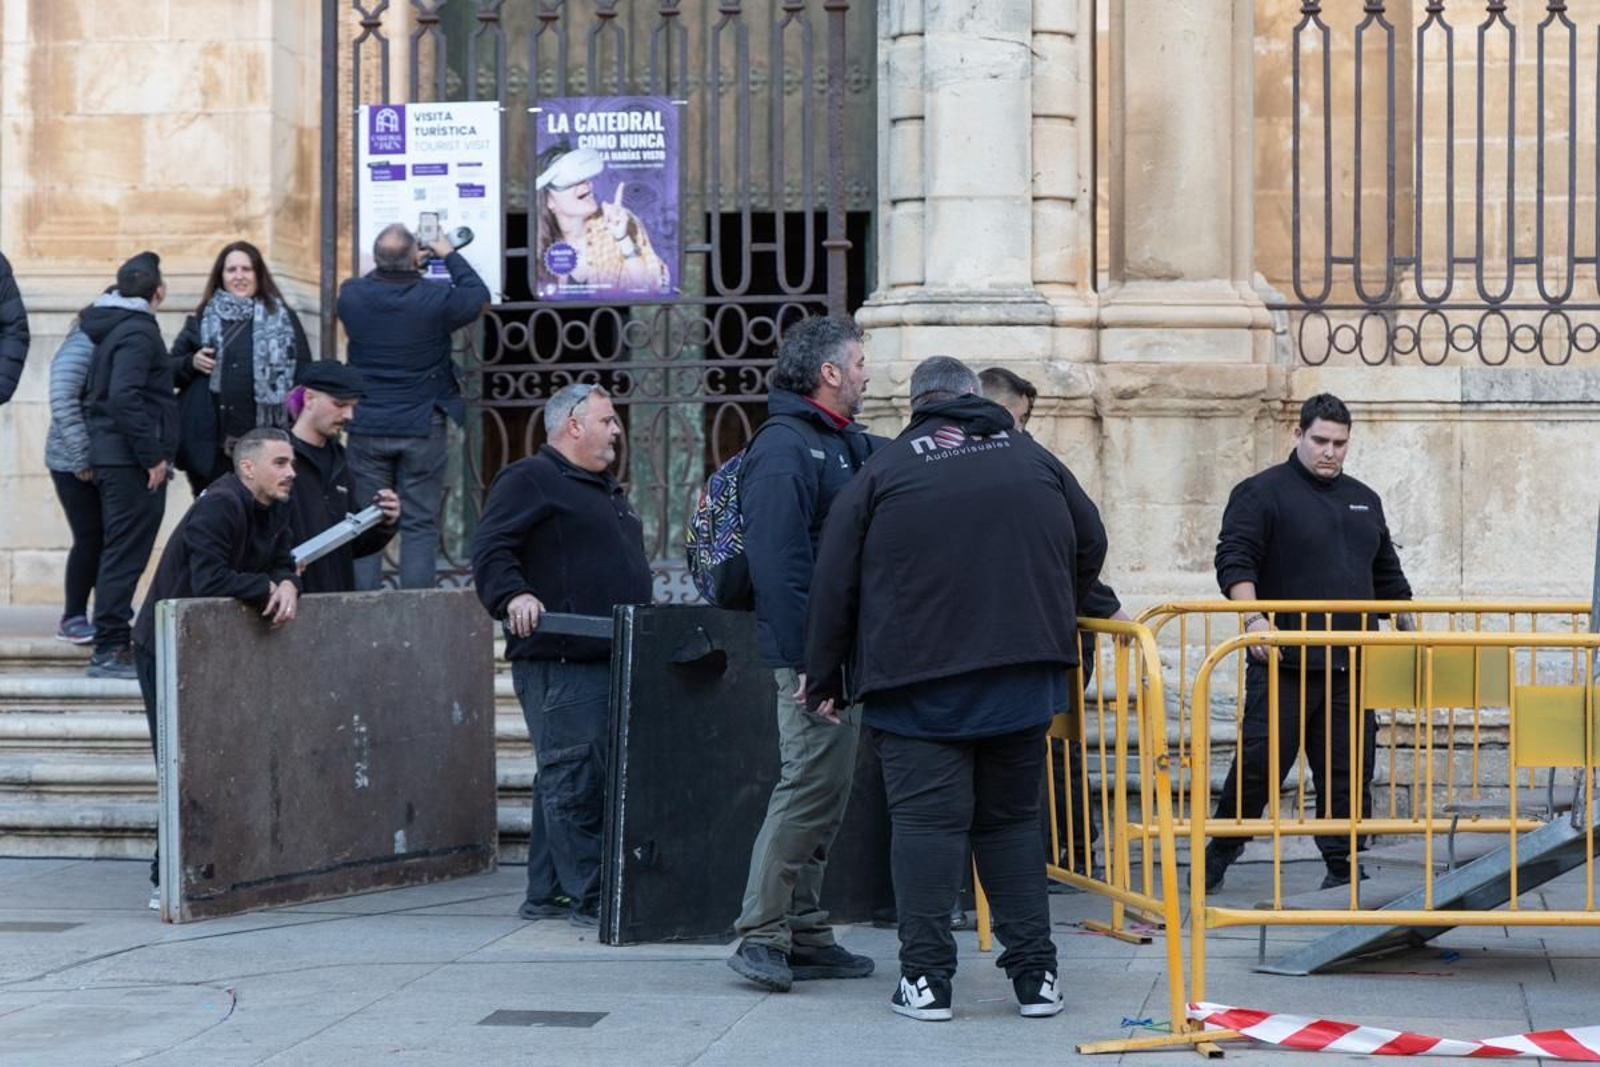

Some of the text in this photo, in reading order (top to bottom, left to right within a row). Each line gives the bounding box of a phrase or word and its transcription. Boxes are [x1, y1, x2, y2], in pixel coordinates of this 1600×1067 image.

[414, 112, 453, 121] VISITA
[548, 111, 665, 133] LA CATEDRAL
[414, 124, 477, 136] TURÍSTICA
[578, 133, 666, 150] COMO NUNCA
[925, 441, 1010, 462] Audiovisuales
